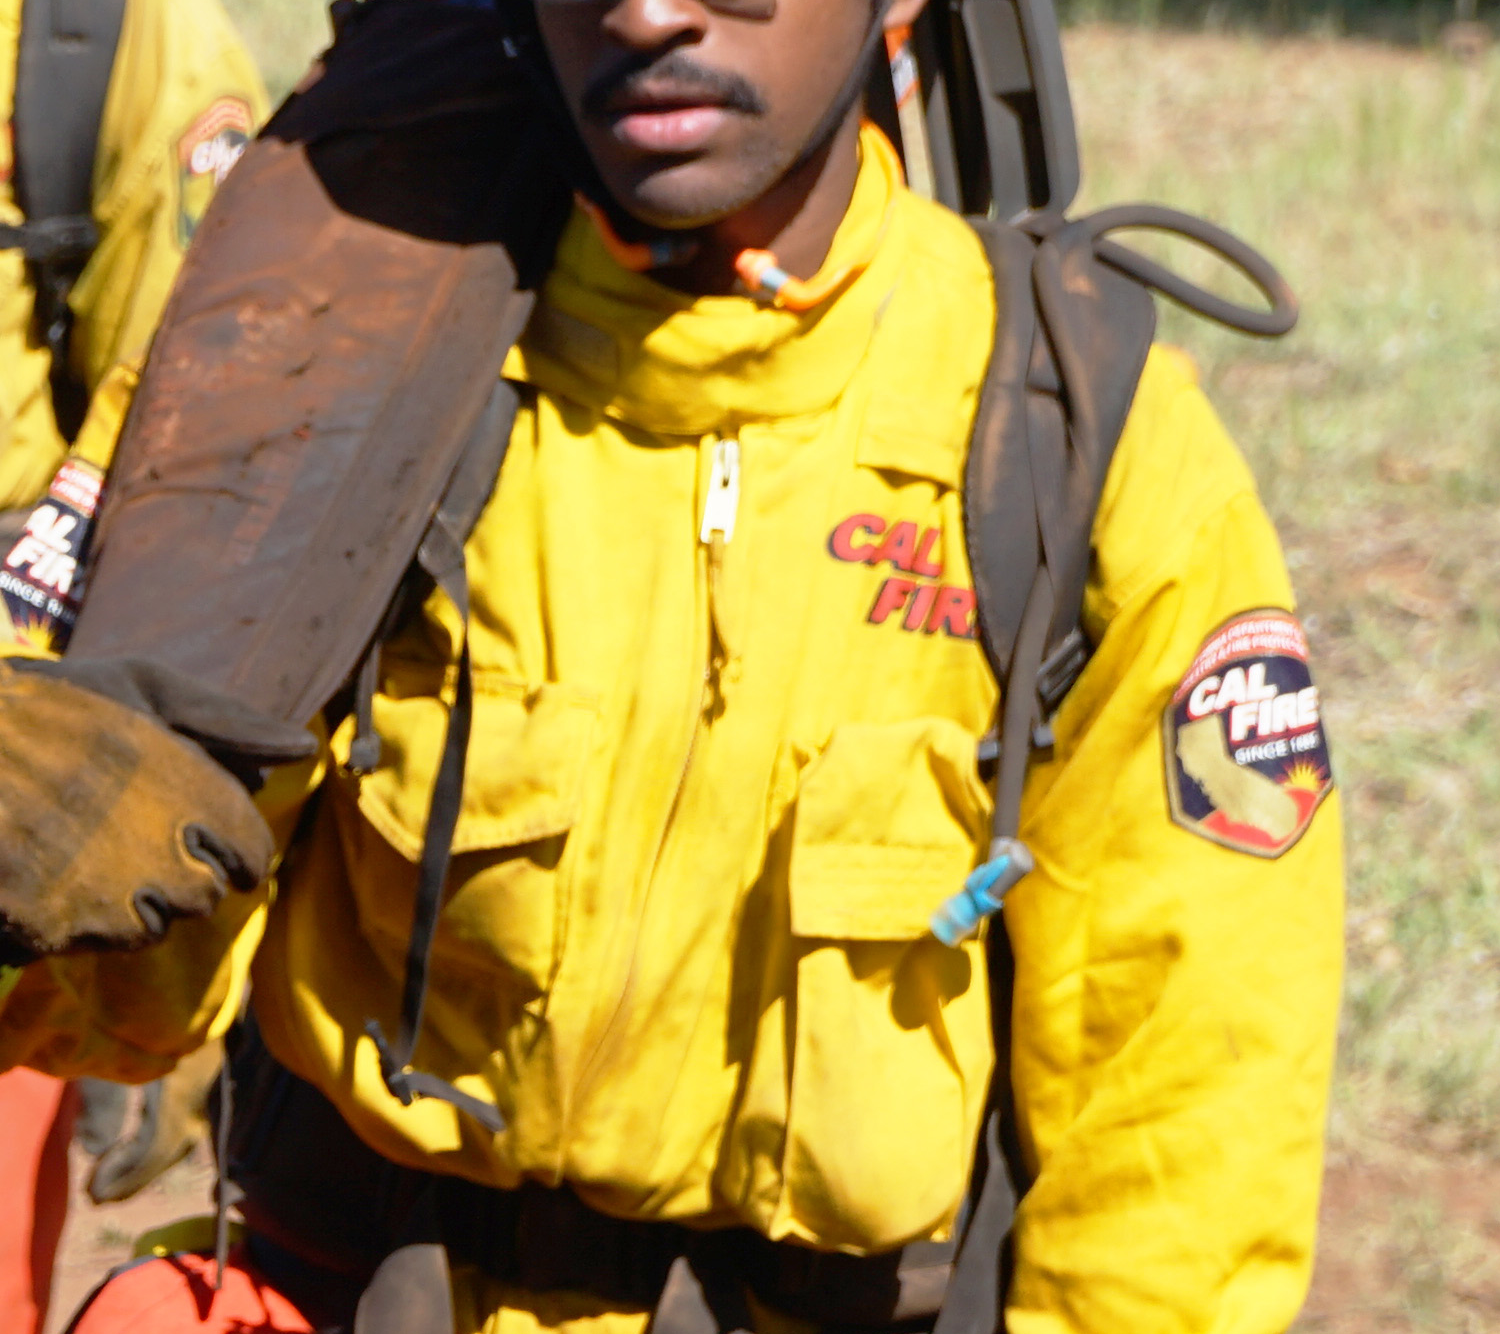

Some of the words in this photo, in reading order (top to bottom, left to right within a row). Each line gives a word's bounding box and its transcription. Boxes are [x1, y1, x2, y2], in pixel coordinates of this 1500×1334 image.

[23, 503, 78, 554] AL
[827, 513, 944, 577] CAL
[5, 536, 80, 596] FIR
[866, 578, 981, 640] FIR
[1188, 662, 1279, 718] CAL
[1230, 685, 1320, 741] FIRE
[1235, 738, 1290, 765] SINCE
